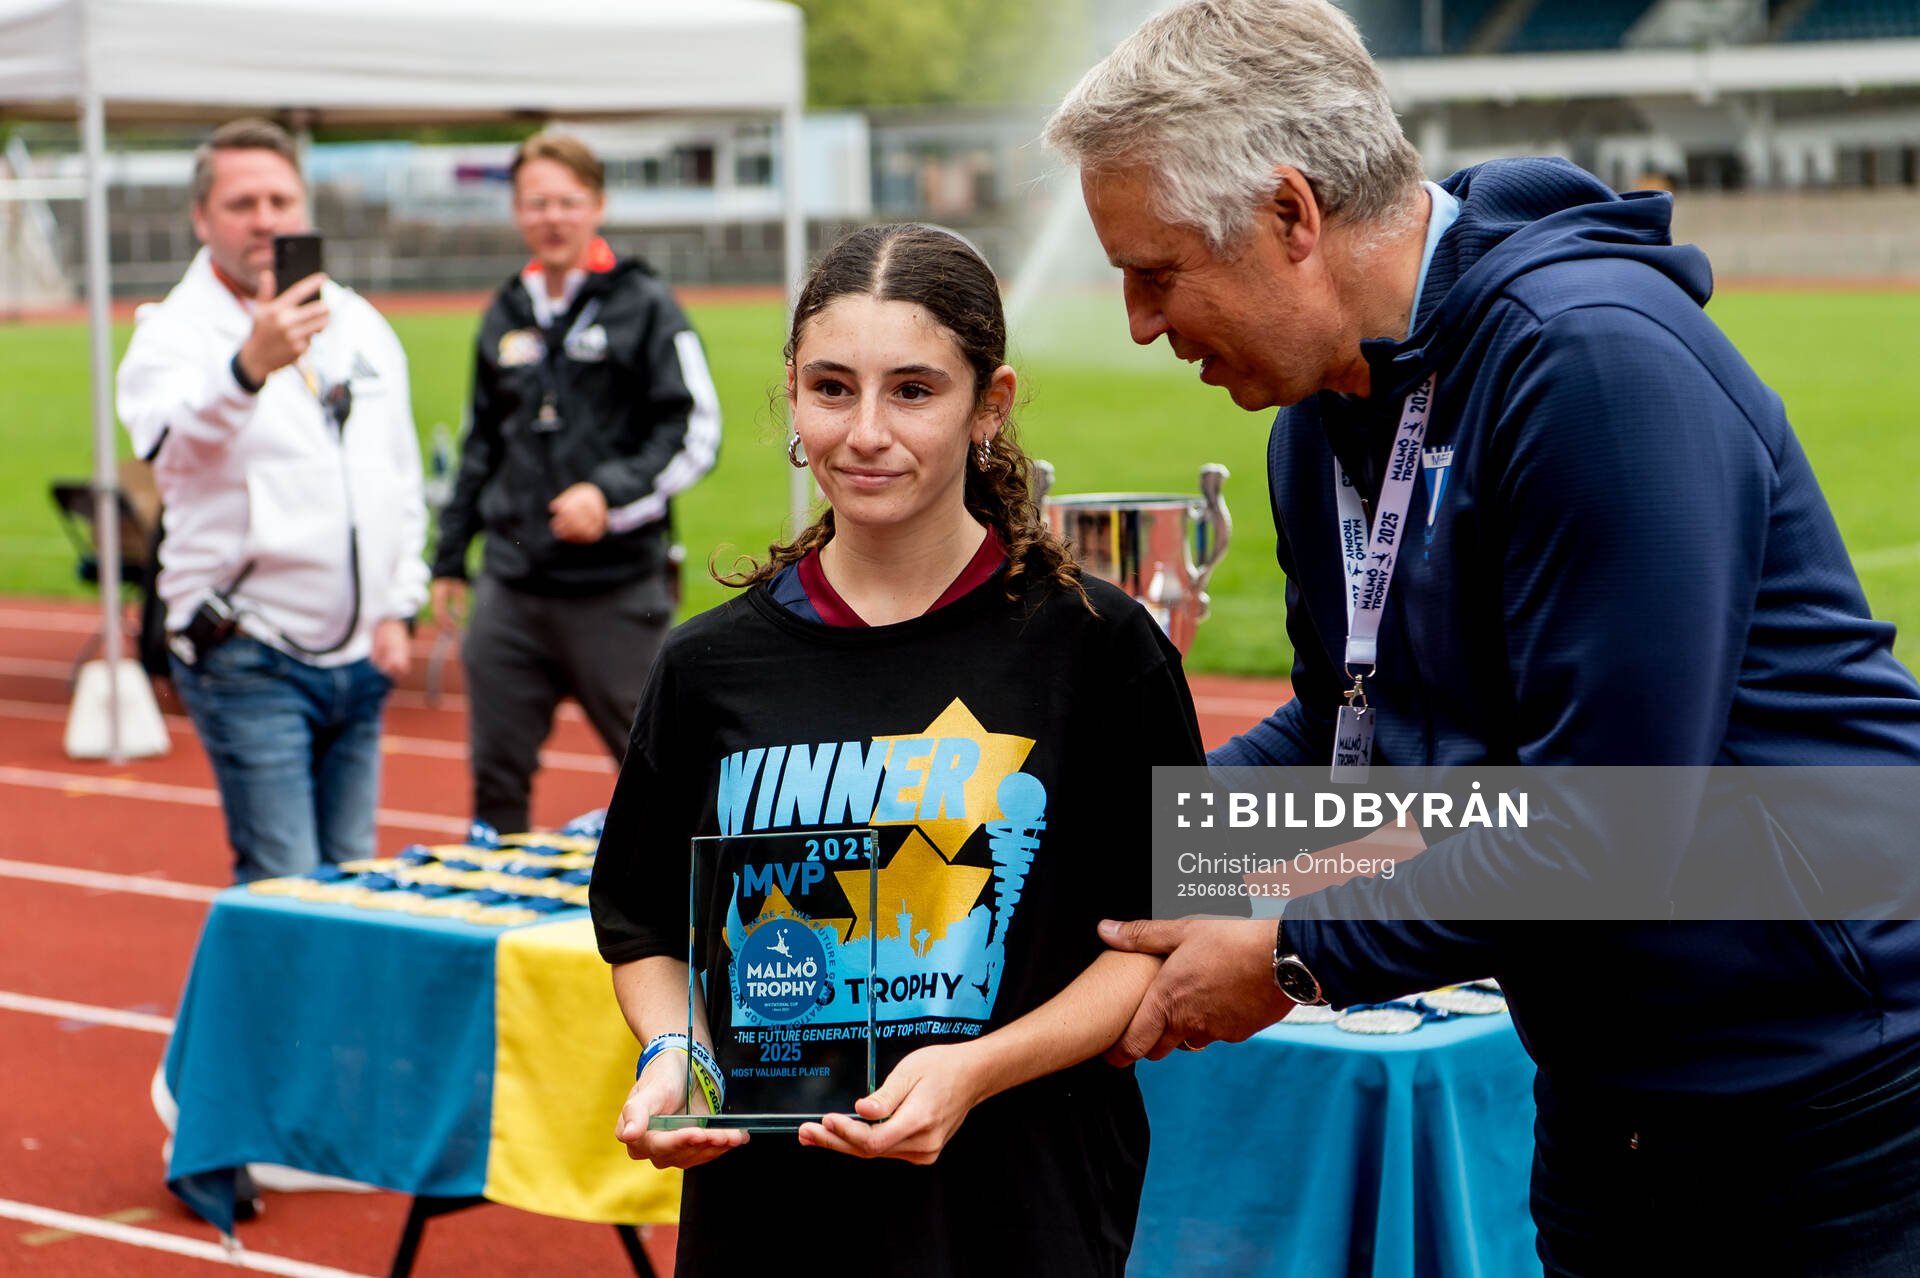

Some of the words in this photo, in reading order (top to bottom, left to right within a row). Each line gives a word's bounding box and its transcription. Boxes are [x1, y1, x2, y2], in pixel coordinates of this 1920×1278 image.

[1401, 440, 1420, 481] TROPHY
[1343, 519, 1354, 560] TROPHY
[1352, 519, 1366, 560] MALMÖ
[1377, 511, 1399, 546] 2025
[1360, 568, 1378, 610] MALMÖ
[1371, 570, 1388, 610] TROPHY
[717, 737, 980, 840] WINNER
[805, 837, 880, 862] 2025
[743, 862, 826, 898] MVP
[746, 957, 818, 979] MALMÖ
[746, 981, 817, 997] TROPHY
[844, 972, 964, 1004] TROPHY
[758, 1030, 801, 1043] FUTURE
[802, 1025, 880, 1041] GENERATION
[882, 1025, 896, 1038] OF
[897, 1024, 913, 1036] TOP
[915, 1020, 951, 1035] FOOTBALL
[951, 1022, 962, 1034] IS
[760, 1043, 802, 1062] 2025
[731, 1067, 754, 1078] MOST
[755, 1067, 798, 1077] VALUABLE
[799, 1066, 830, 1077] PLAYER
